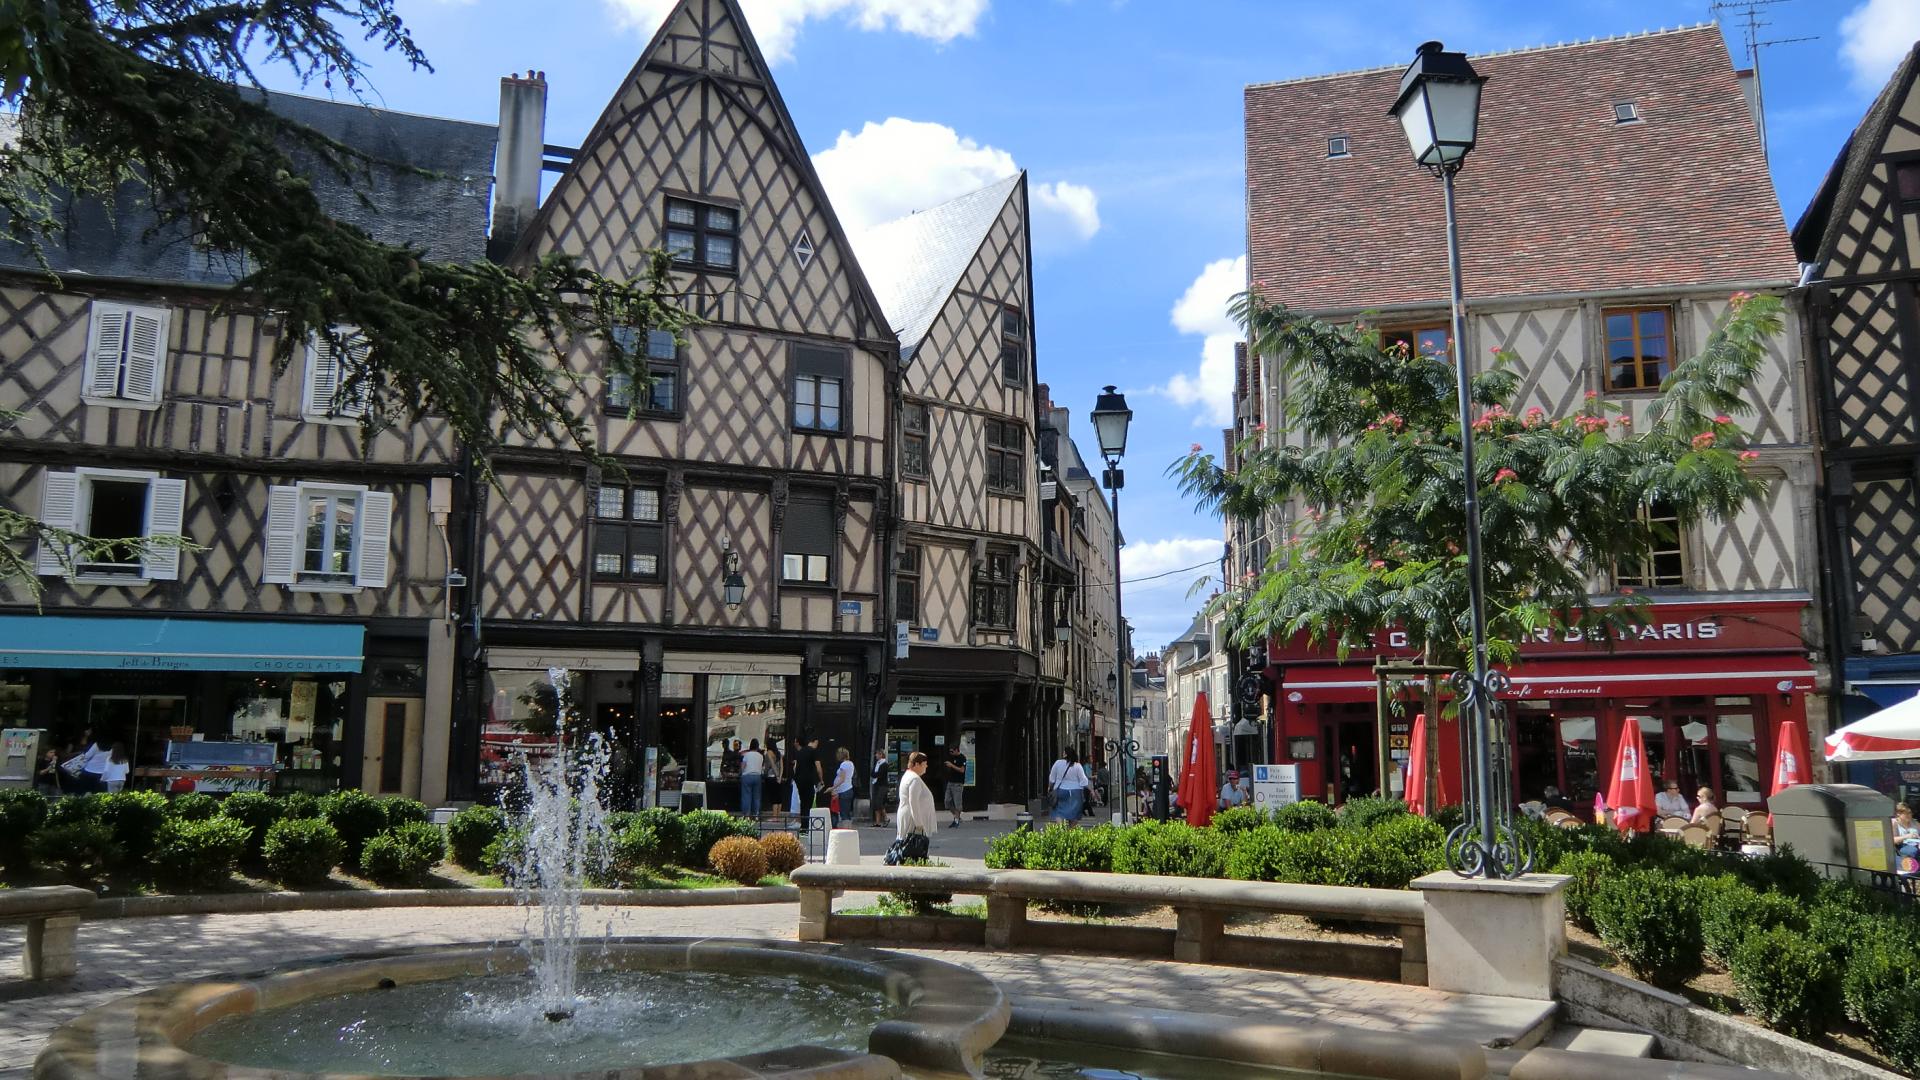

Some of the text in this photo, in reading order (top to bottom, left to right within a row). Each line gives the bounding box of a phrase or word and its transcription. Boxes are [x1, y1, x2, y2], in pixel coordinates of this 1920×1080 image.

[254, 661, 342, 670] CHOCOLATS
[1507, 684, 1601, 698] café restaurant
